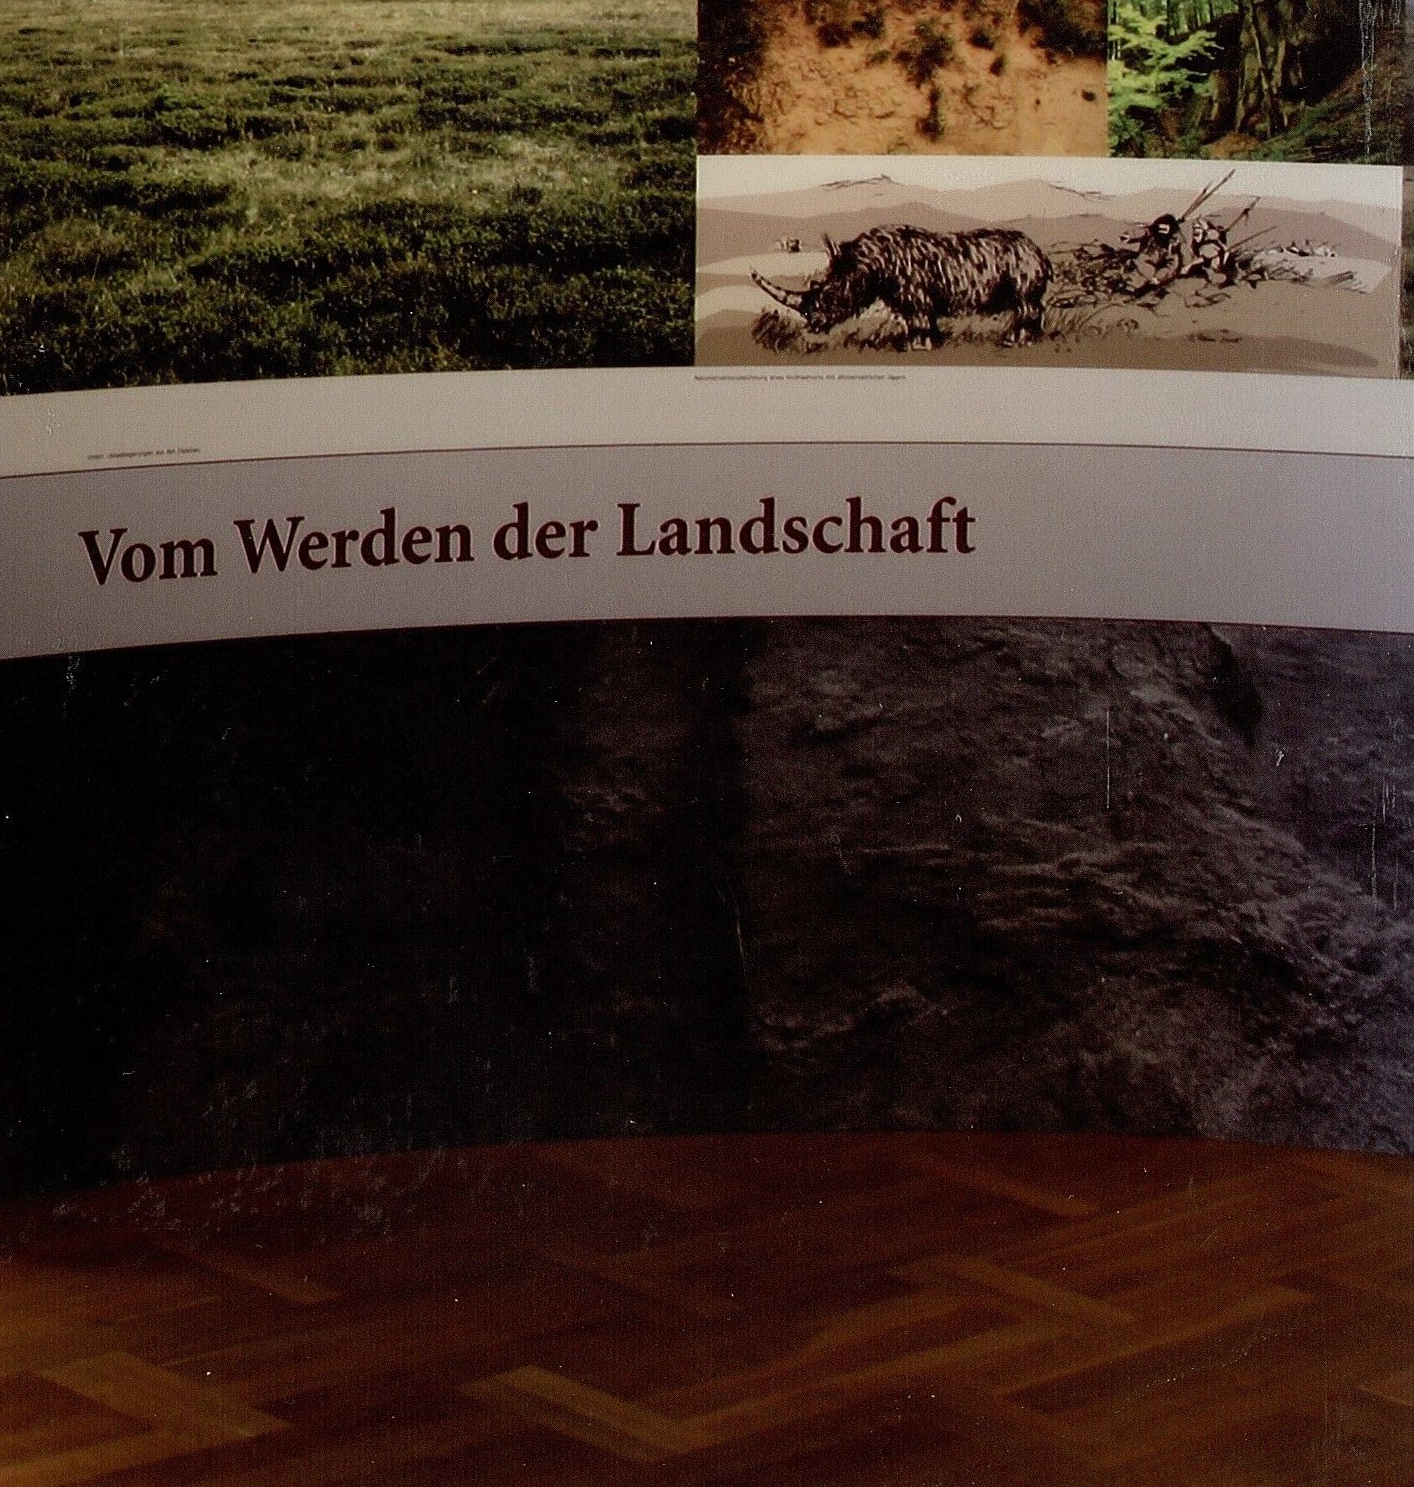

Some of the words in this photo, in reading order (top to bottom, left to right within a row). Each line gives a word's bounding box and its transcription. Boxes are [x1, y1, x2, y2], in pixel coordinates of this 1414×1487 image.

[78, 527, 218, 585] Vom
[233, 507, 475, 574] Werden
[493, 502, 599, 561] der
[616, 496, 976, 558] Landschaft
